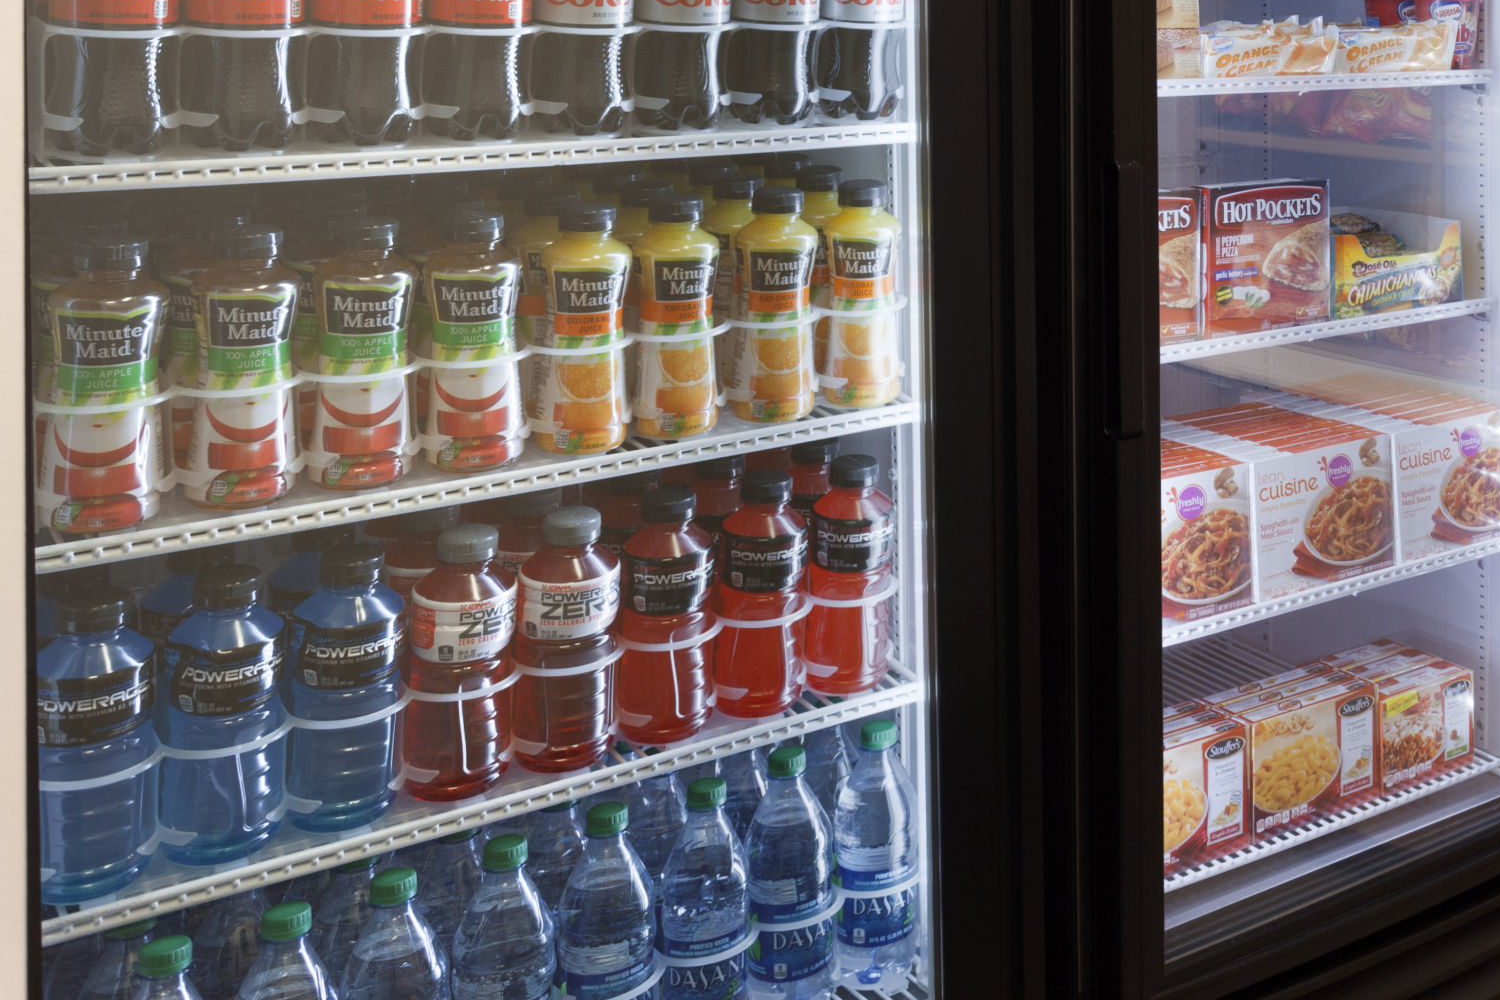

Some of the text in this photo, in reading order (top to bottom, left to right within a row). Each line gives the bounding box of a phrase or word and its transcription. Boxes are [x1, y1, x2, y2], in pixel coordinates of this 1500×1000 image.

[1216, 44, 1279, 69] ORANGE
[1346, 39, 1403, 61] ORANGE
[1225, 58, 1277, 78] CREAM
[1222, 193, 1321, 223] HOT POCKETS
[1221, 233, 1253, 246] PEPPERONI
[1221, 246, 1239, 257] PIZZA
[441, 286, 505, 302] Minute
[570, 292, 612, 307] Maid
[451, 300, 499, 317] Maid
[343, 312, 394, 329] Maid
[65, 323, 143, 342] Minute
[228, 324, 277, 341] Maid
[471, 324, 499, 334] APPLE
[365, 336, 393, 347] APPLE
[462, 333, 488, 343] JUICE
[76, 340, 132, 359] Maid
[352, 346, 381, 356] JUICE
[237, 358, 266, 368] JUICE
[100, 367, 132, 378] APPLE
[86, 378, 118, 389] JUICE
[1460, 437, 1481, 449] freshly
[1400, 446, 1452, 470] cuisine
[1256, 469, 1286, 485] lean
[1327, 463, 1352, 477] freshly
[1259, 476, 1318, 502] cuisine
[1178, 494, 1204, 509] freshly
[1342, 697, 1371, 714] Stouffer's
[1209, 738, 1243, 758] Stouffer's
